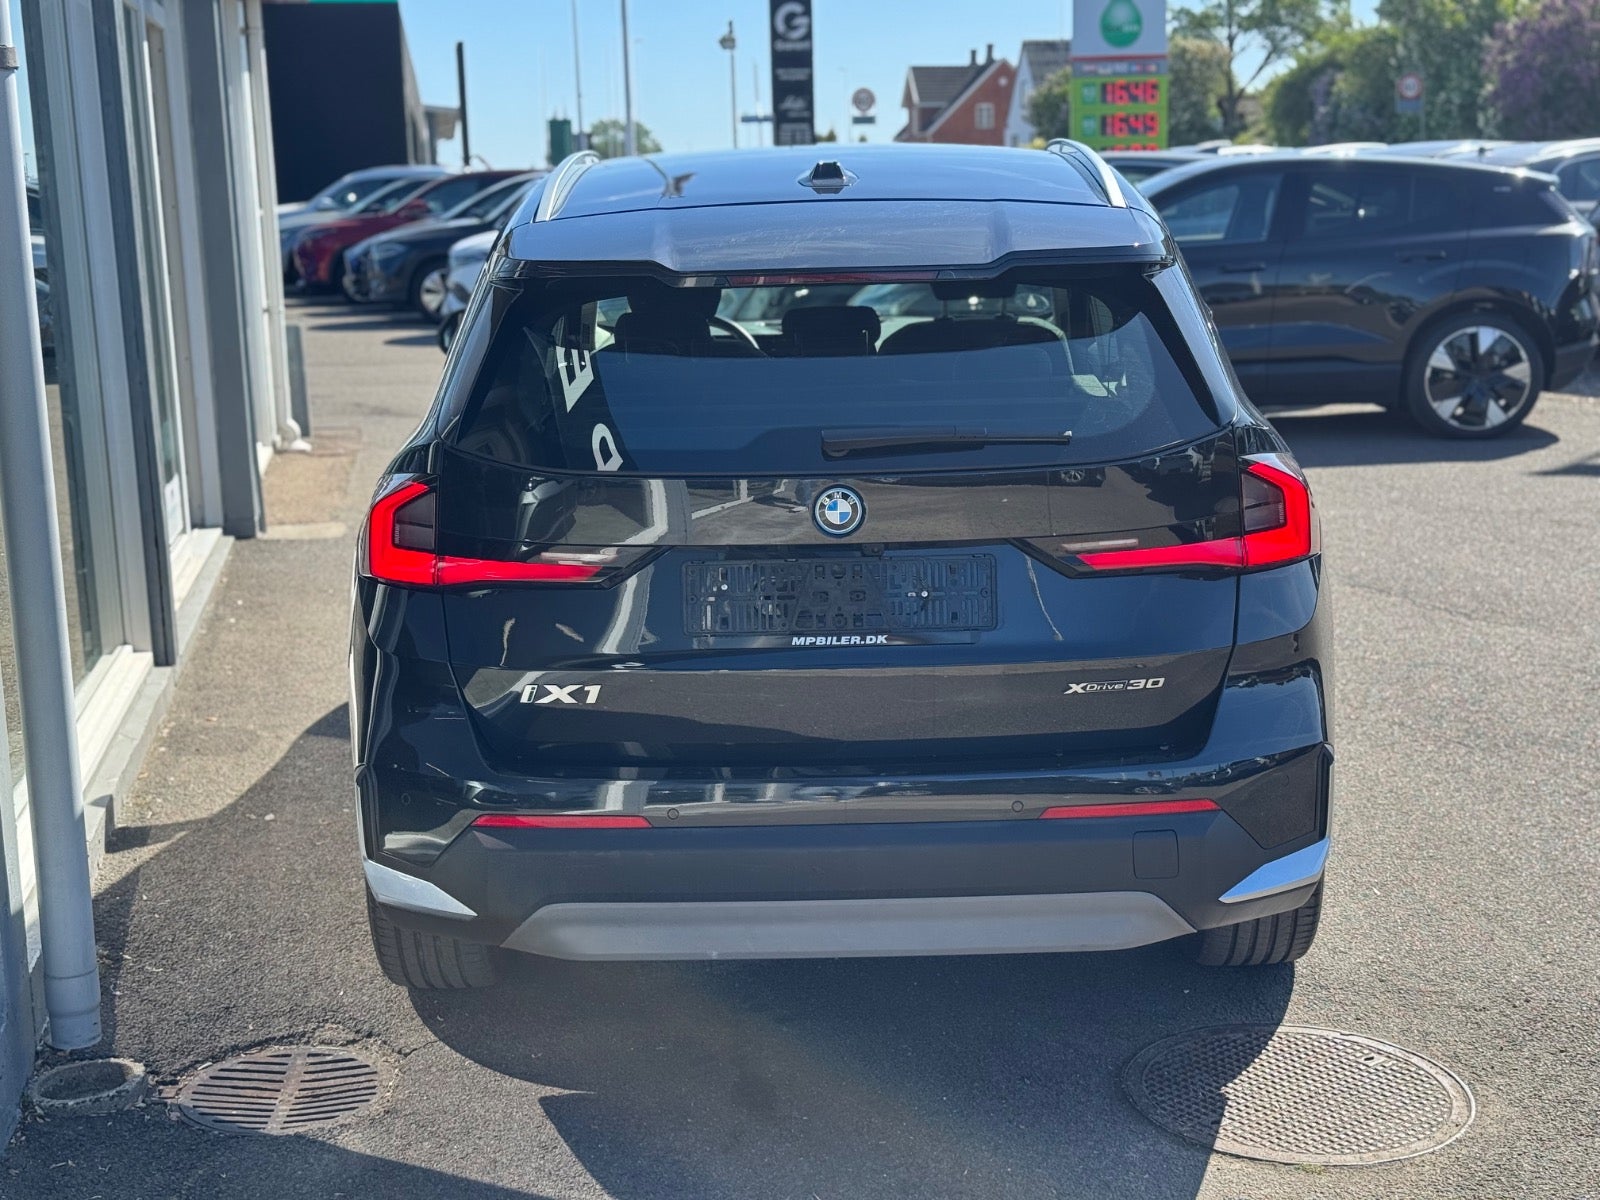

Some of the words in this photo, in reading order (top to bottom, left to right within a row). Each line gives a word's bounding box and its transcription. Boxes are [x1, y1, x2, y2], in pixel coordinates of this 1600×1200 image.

[821, 491, 856, 506] BMW
[791, 634, 889, 646] MPBILER.DK
[520, 684, 602, 704] iX1
